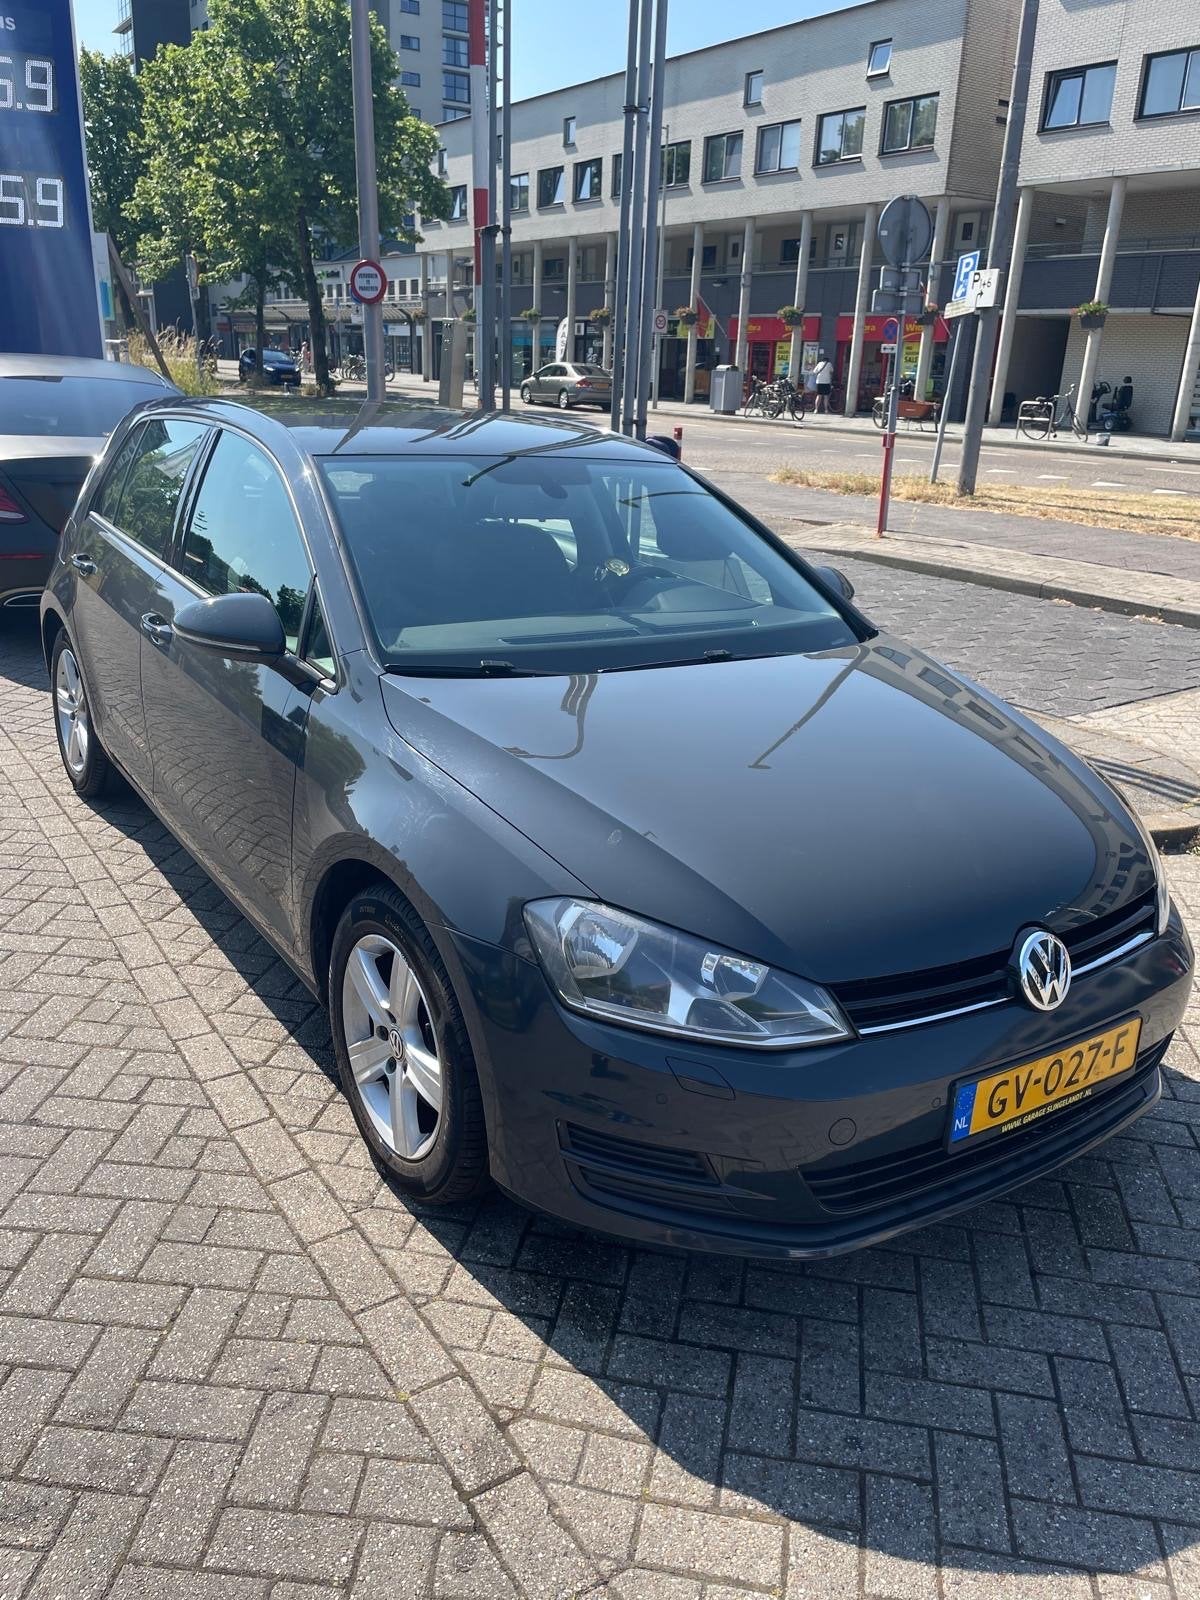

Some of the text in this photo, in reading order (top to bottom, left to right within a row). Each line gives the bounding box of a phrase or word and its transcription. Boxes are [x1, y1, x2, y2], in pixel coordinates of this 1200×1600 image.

[960, 257, 974, 281] P
[987, 1029, 1130, 1119] GV-027-F
[954, 1117, 969, 1131] NL
